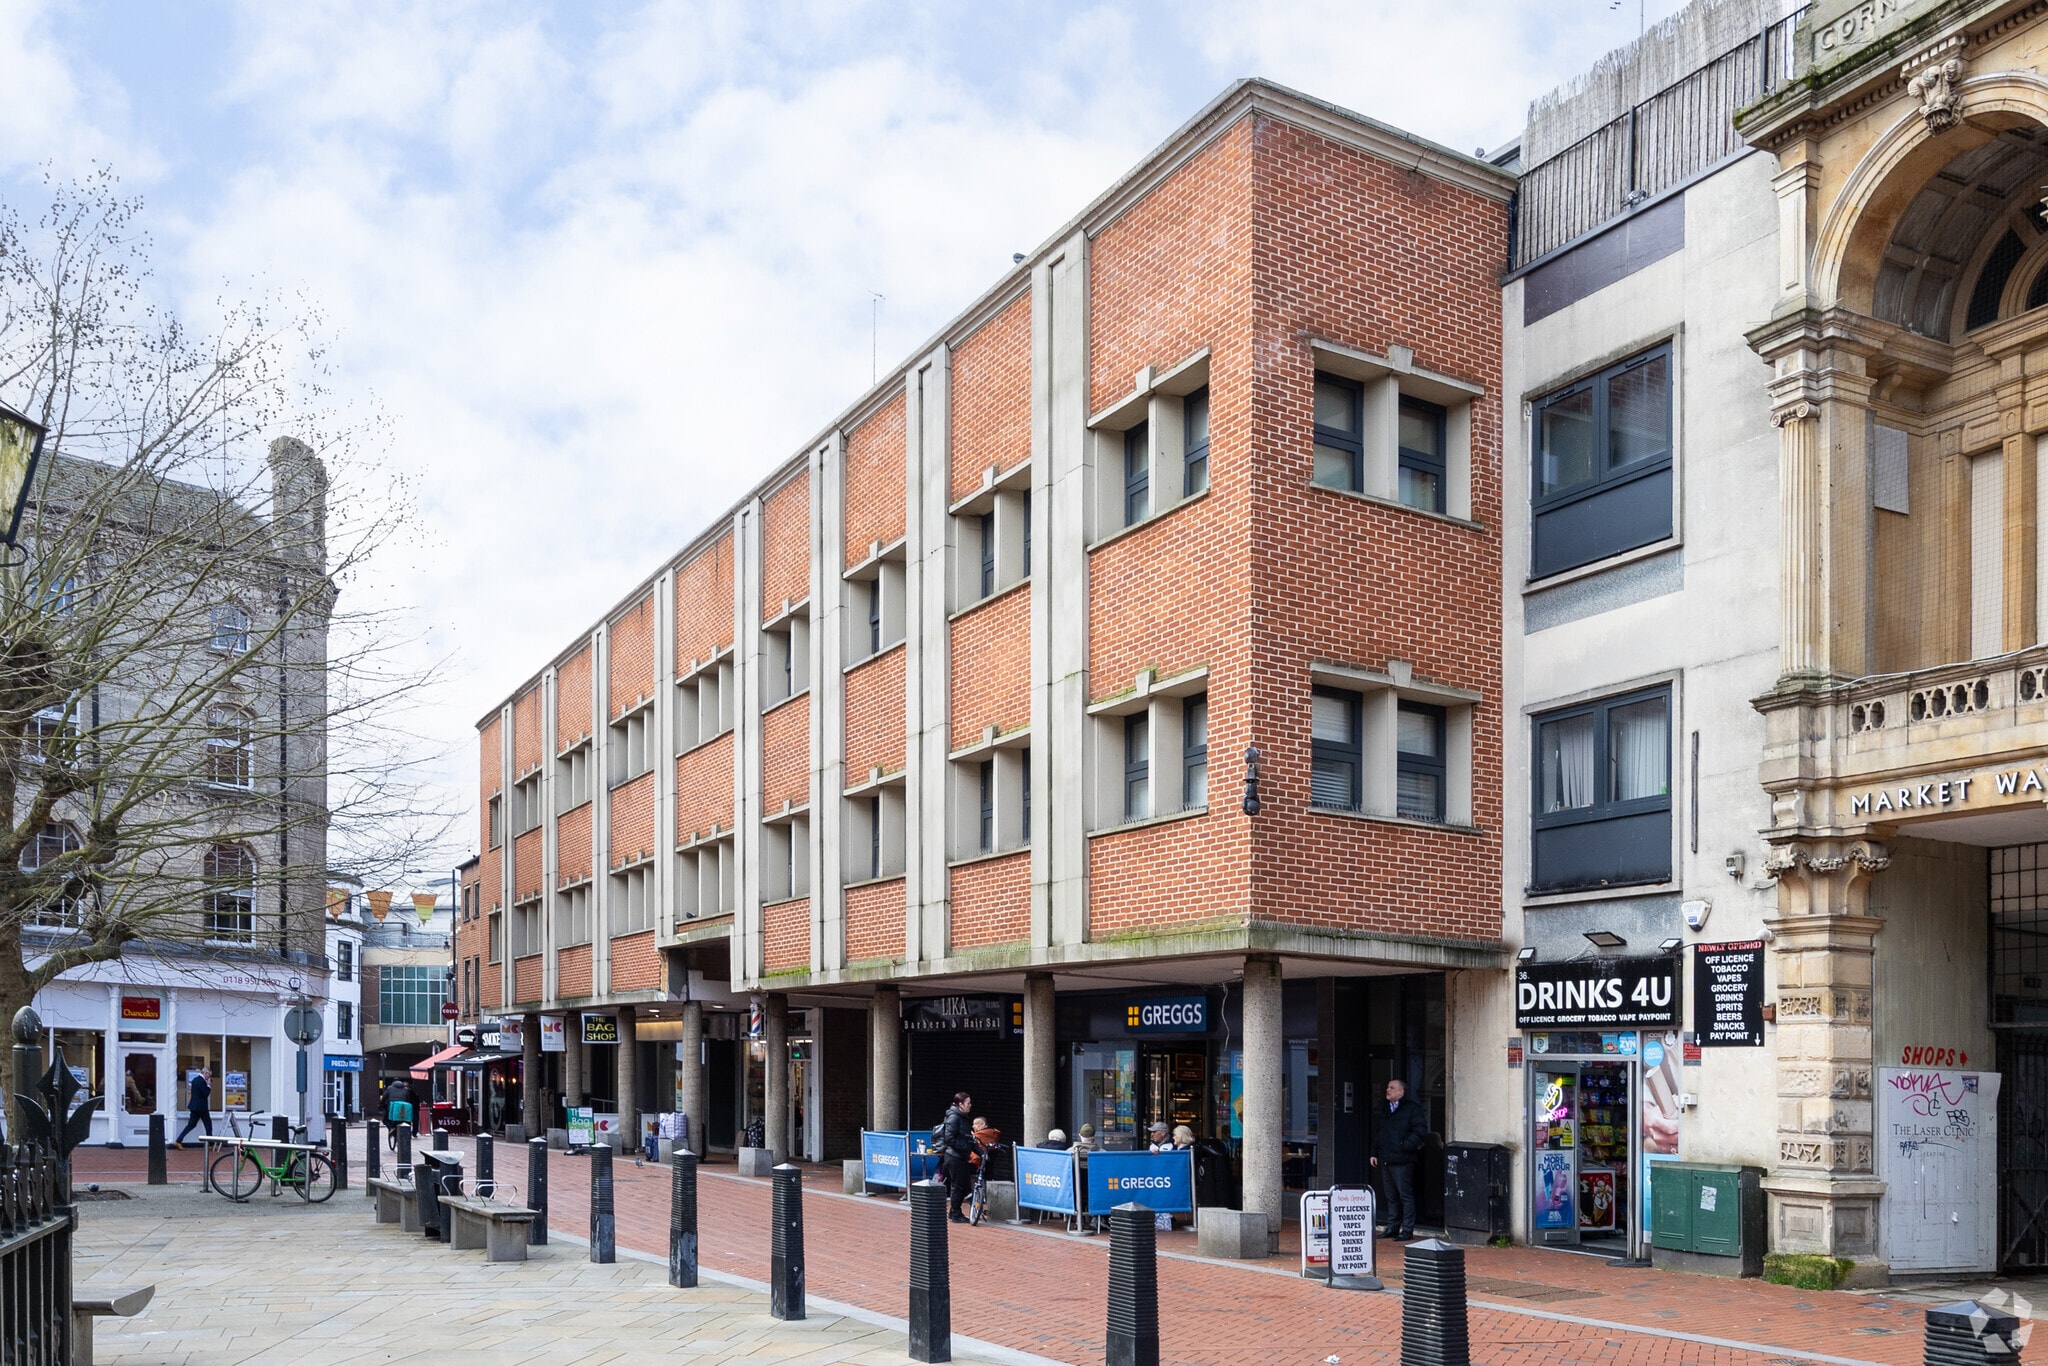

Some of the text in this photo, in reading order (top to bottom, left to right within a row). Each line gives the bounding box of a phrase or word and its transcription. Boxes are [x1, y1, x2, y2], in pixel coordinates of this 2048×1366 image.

[1851, 767, 2048, 815] MARKET WA
[1698, 944, 1726, 952] NEWLY
[1705, 954, 1754, 964] OFF LICENCE
[1710, 964, 1748, 973] TOBACCO
[1716, 974, 1742, 982] VAPES
[1710, 984, 1748, 992] GROCERY
[1518, 976, 1671, 1010] DRINKS 4U
[1715, 993, 1744, 1002] DRINKS
[941, 997, 969, 1016] LIKA
[1715, 1003, 1743, 1012] SPRITS
[123, 1009, 158, 1018] Chancellors
[1142, 1003, 1202, 1026] GREGGS
[1638, 1013, 1671, 1021] PAYPOINT
[1716, 1012, 1743, 1021] BEERS
[586, 1023, 615, 1032] BAG
[904, 1020, 946, 1029] Barbers
[963, 1018, 983, 1028] Hair
[986, 1018, 1000, 1028] Sal
[1713, 1022, 1745, 1030] SNACKS
[586, 1032, 616, 1041] SHOP
[1710, 1031, 1749, 1040] PAY POINT
[1619, 1040, 1636, 1048] ZYN
[1901, 1046, 1956, 1067] SHOPS
[1893, 1124, 1913, 1135] THE
[1914, 1124, 1941, 1136] LASER
[878, 1154, 899, 1166] GREGGS
[1543, 1156, 1565, 1164] MORE
[1538, 1163, 1571, 1171] FLAVOUR
[1032, 1173, 1061, 1188] GREGGS
[1120, 1176, 1171, 1189] GREGGS
